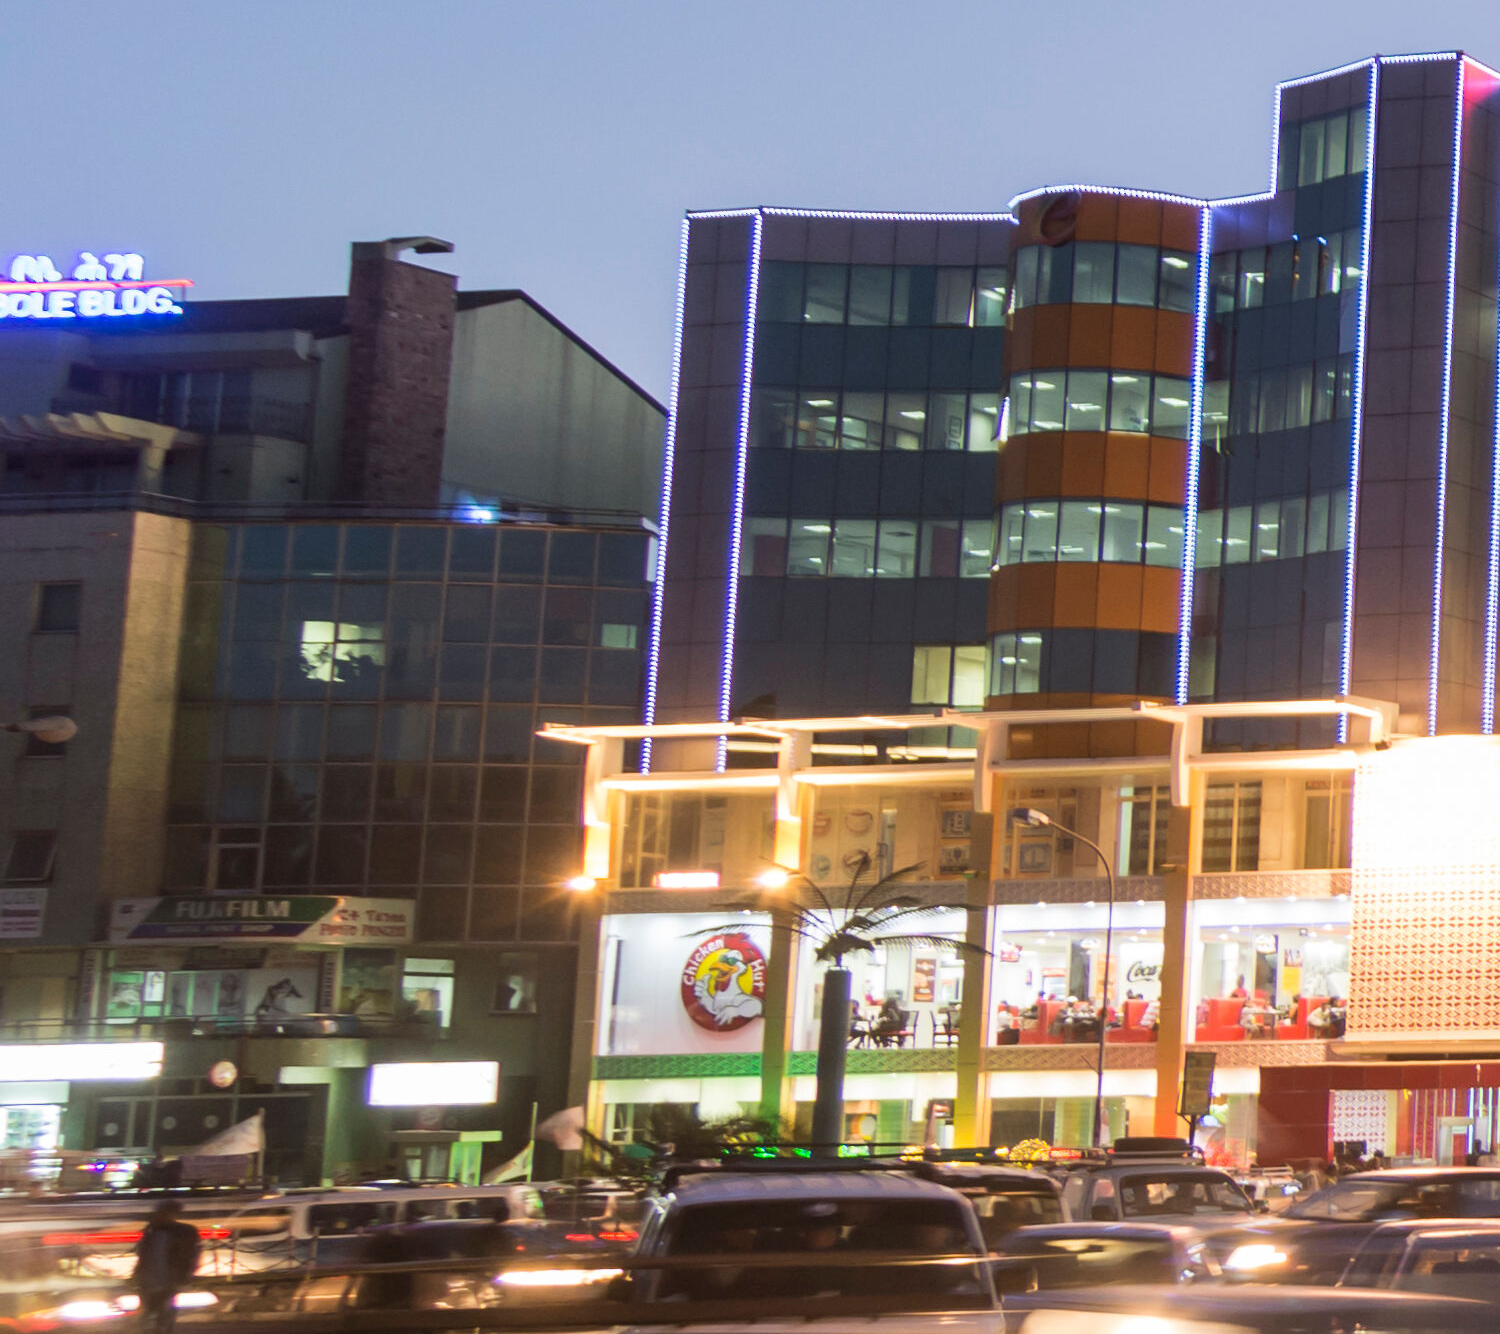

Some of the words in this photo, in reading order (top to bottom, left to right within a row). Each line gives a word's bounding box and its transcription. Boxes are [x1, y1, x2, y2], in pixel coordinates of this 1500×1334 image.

[176, 899, 291, 919] FUJIFILM
[683, 938, 725, 986] Chicken
[747, 958, 766, 993] Hut
